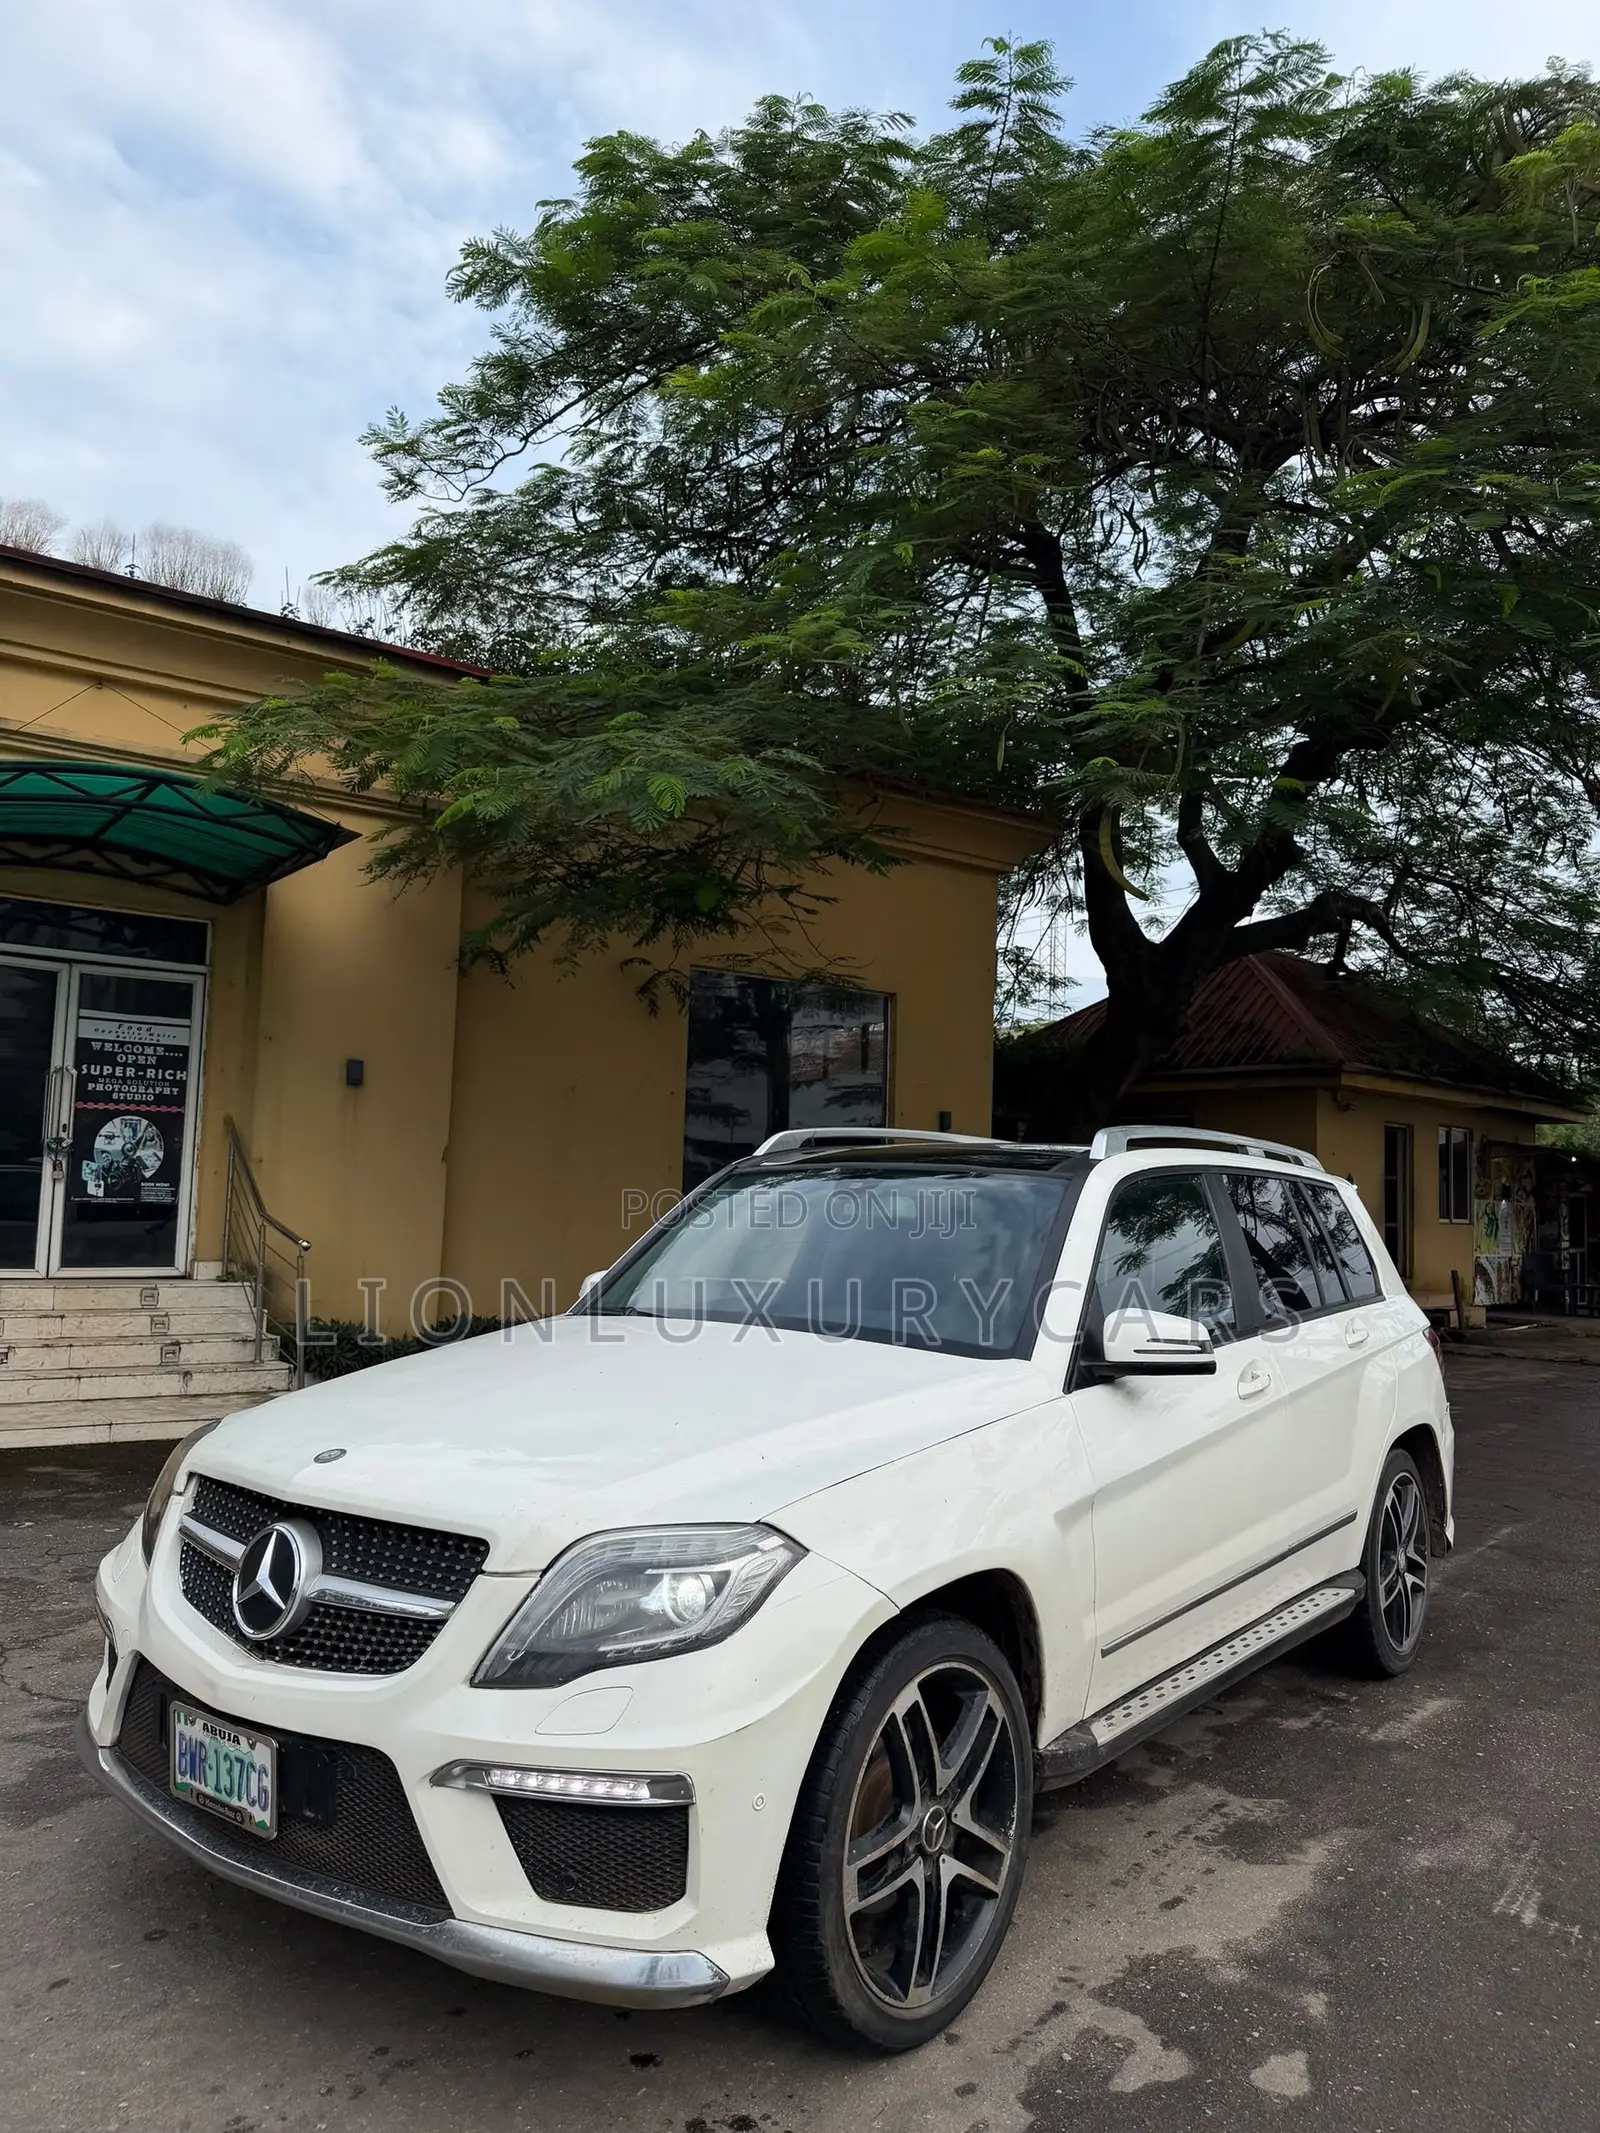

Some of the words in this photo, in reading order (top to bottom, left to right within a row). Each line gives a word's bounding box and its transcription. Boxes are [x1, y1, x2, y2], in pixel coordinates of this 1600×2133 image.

[117, 1023, 152, 1033] Food
[116, 1053, 157, 1065] OPEN
[81, 1063, 187, 1081] SUPER-RICH
[98, 1077, 123, 1085] MEGA
[126, 1078, 170, 1087] SOLUTION
[87, 1082, 180, 1095] PHOTOGRAPHY
[112, 1092, 154, 1102] STUDIO
[202, 1722, 241, 1746] ABUJA
